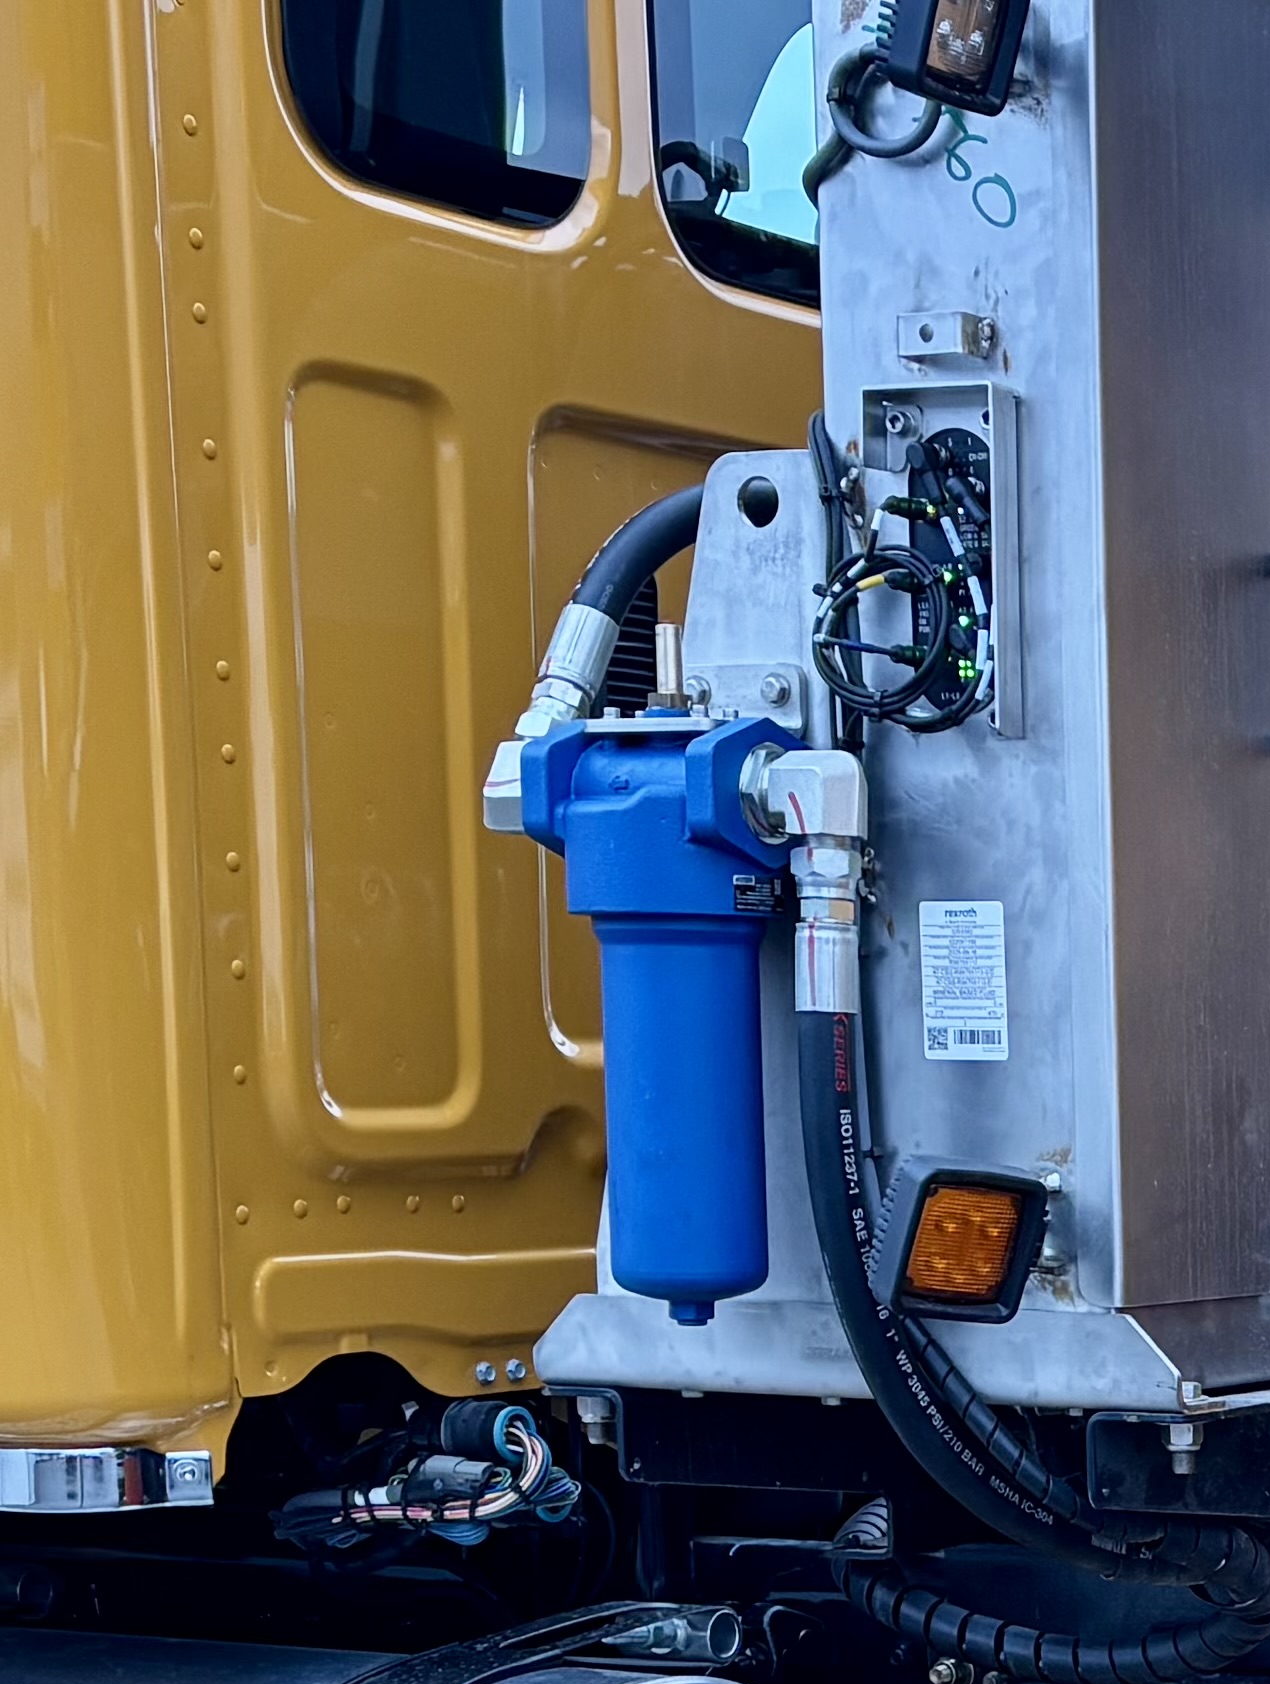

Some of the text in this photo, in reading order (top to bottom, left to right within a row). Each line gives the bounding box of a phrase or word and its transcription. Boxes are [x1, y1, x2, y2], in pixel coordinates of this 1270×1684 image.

[833, 1025, 849, 1093] SERIES
[839, 1109, 860, 1195] ISO11237-1
[852, 1207, 869, 1242] SAE
[896, 1350, 913, 1374] WP
[908, 1375, 931, 1407] 3045
[960, 1449, 985, 1476] BAR
[989, 1475, 1020, 1505] MSHA
